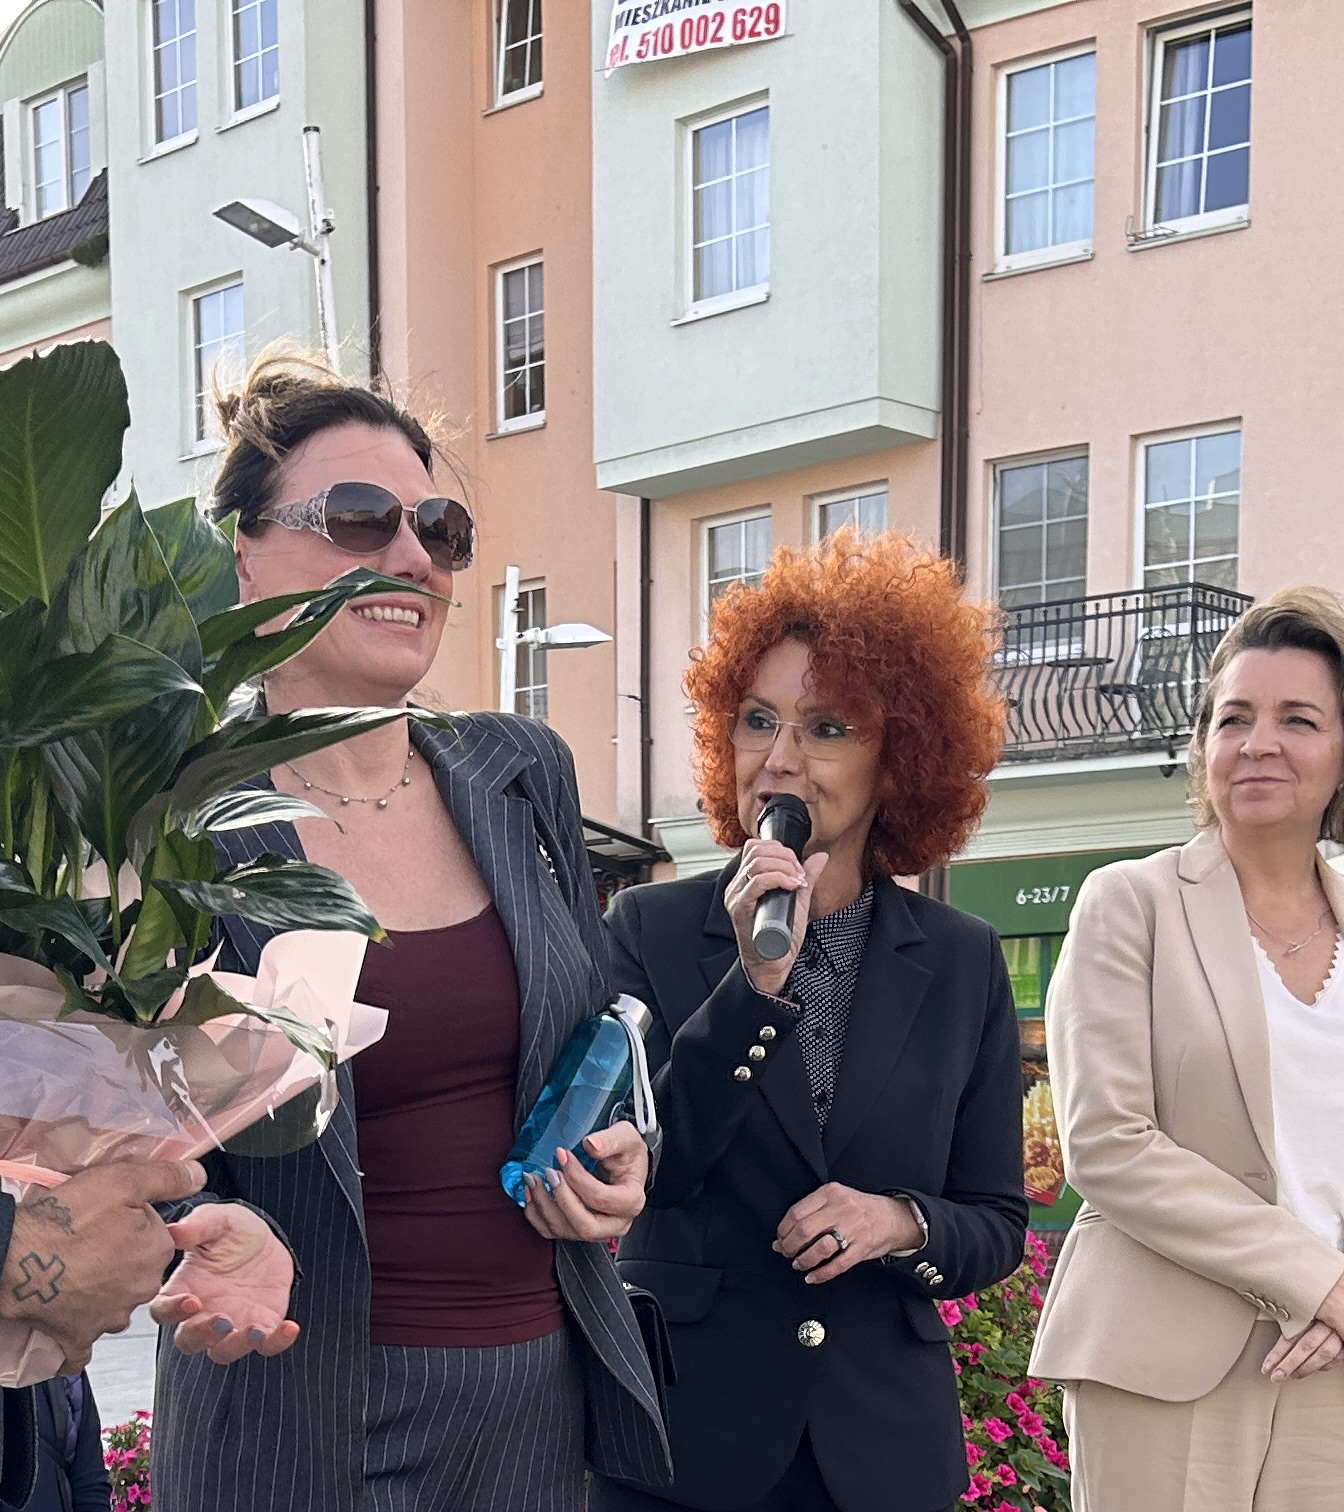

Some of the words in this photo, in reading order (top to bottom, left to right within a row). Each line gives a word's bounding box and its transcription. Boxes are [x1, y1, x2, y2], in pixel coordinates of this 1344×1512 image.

[615, 0, 710, 30] MIESZKAN
[636, 23, 674, 59] 510
[680, 12, 725, 50] 002
[732, 3, 781, 41] 629
[1015, 885, 1071, 905] 6-23/7
